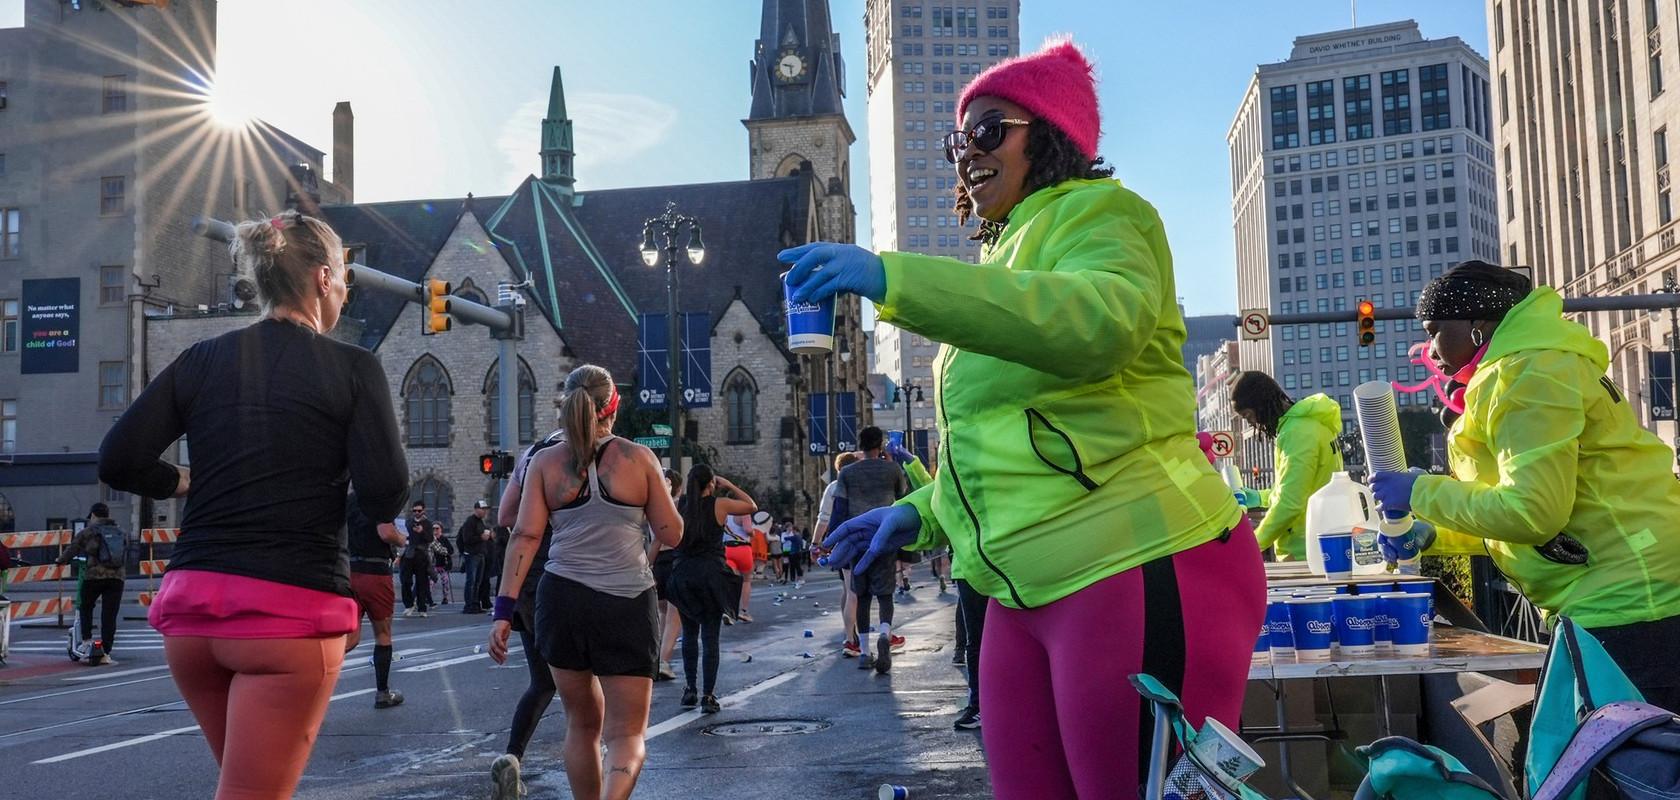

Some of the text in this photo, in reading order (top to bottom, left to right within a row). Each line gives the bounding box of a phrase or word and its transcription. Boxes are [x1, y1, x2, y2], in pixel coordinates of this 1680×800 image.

[1309, 34, 1400, 53] DAVID WHITNEY BUILDING
[56, 339, 75, 347] God!
